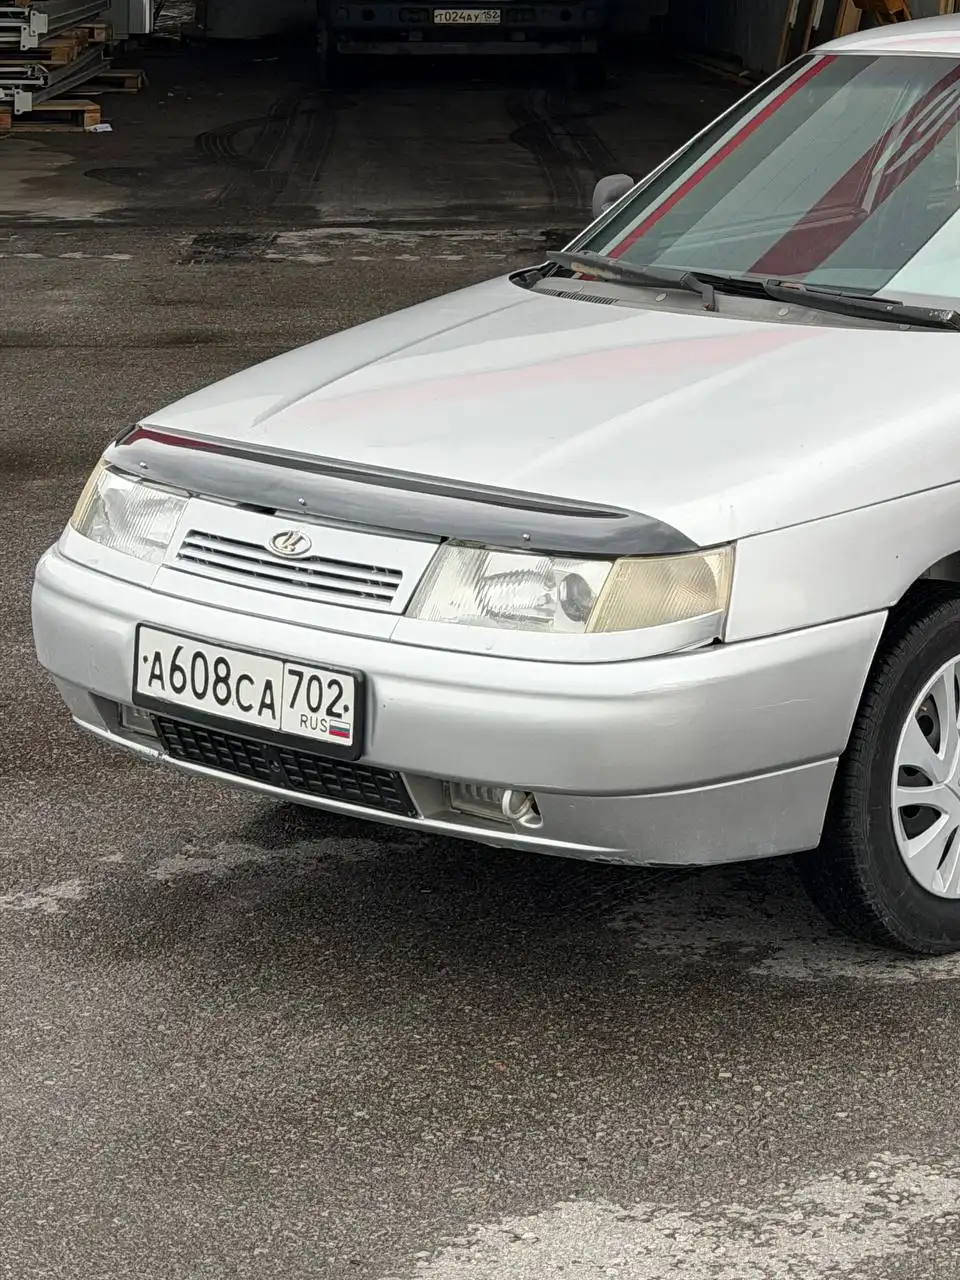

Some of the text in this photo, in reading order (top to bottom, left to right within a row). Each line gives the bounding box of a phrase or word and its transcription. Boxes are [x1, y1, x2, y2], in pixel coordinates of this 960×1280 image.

[147, 645, 344, 721] А608СА 702
[300, 713, 328, 733] RUS
